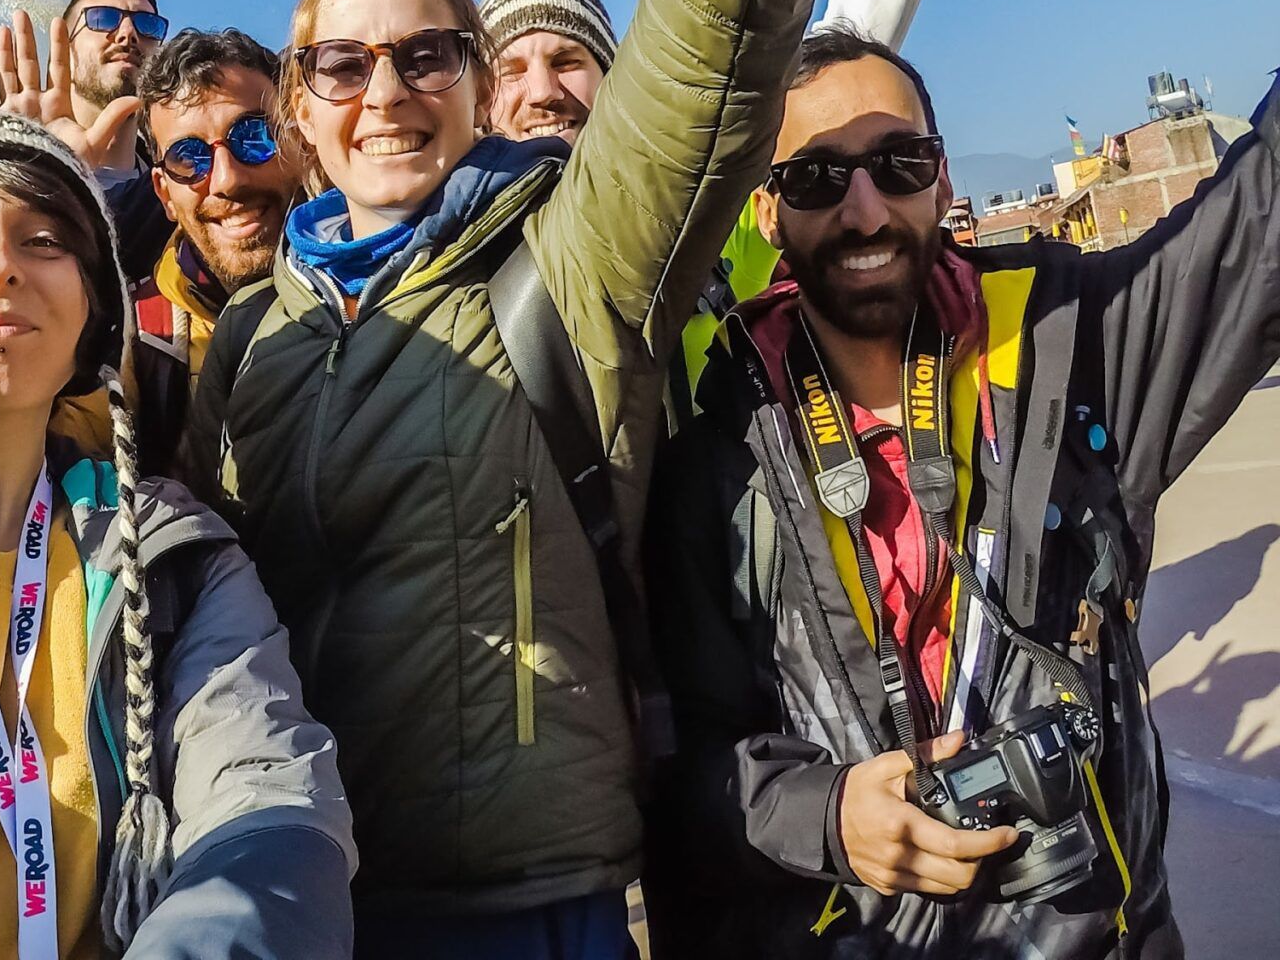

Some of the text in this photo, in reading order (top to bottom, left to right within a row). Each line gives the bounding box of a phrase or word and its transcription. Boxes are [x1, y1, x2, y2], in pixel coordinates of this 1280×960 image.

[803, 373, 842, 445] Nikon
[911, 353, 936, 431] Nikon
[26, 500, 48, 559] WEROAD
[15, 582, 42, 656] WEROAD
[23, 818, 49, 918] WEROAD
